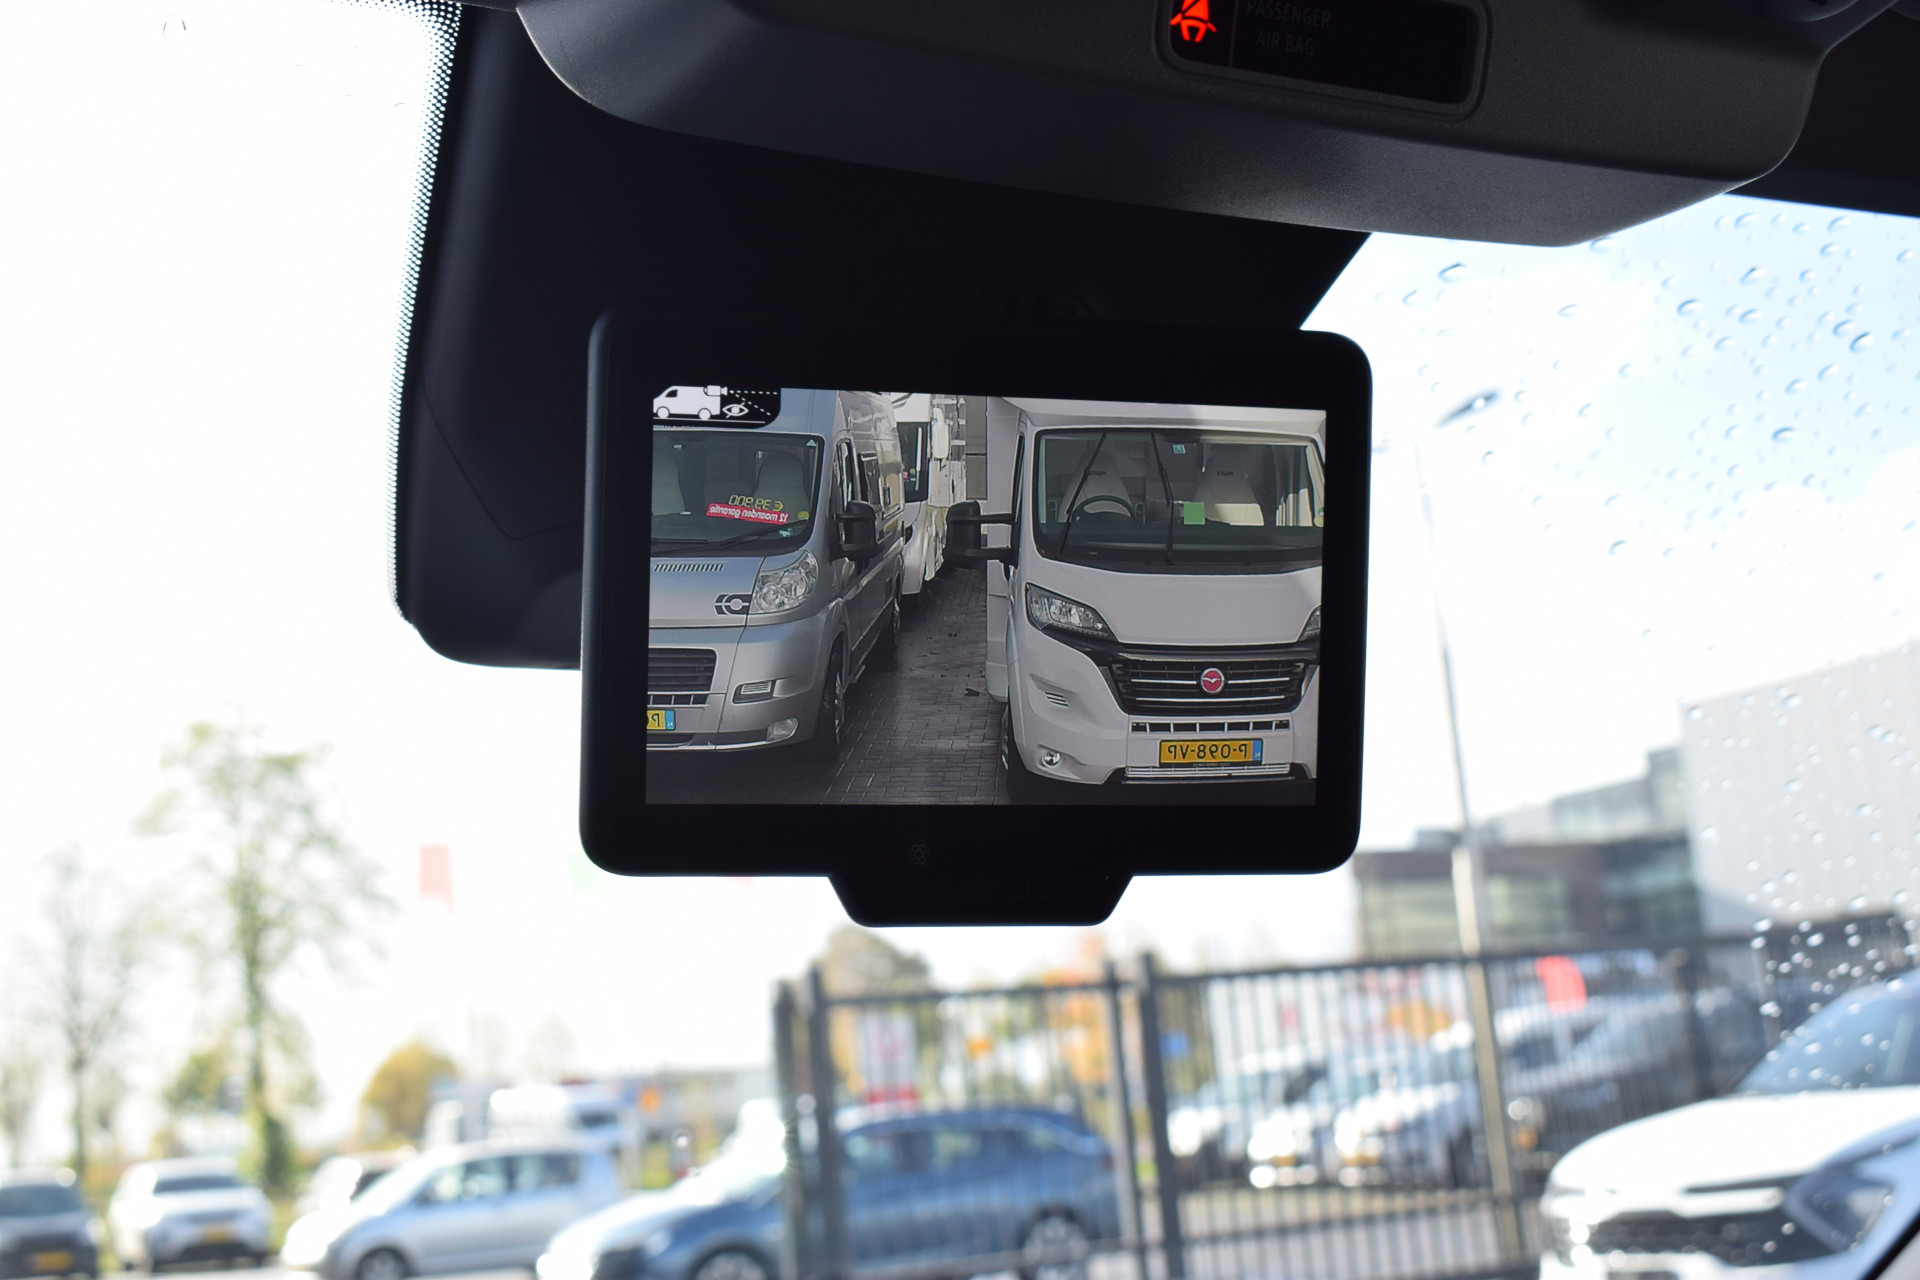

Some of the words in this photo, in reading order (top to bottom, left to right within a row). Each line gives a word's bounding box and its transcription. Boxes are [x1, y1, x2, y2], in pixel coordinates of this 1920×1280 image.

[1246, 0, 1331, 28] PASSENGER
[1256, 30, 1280, 49] AIR
[1286, 34, 1314, 55] BAG
